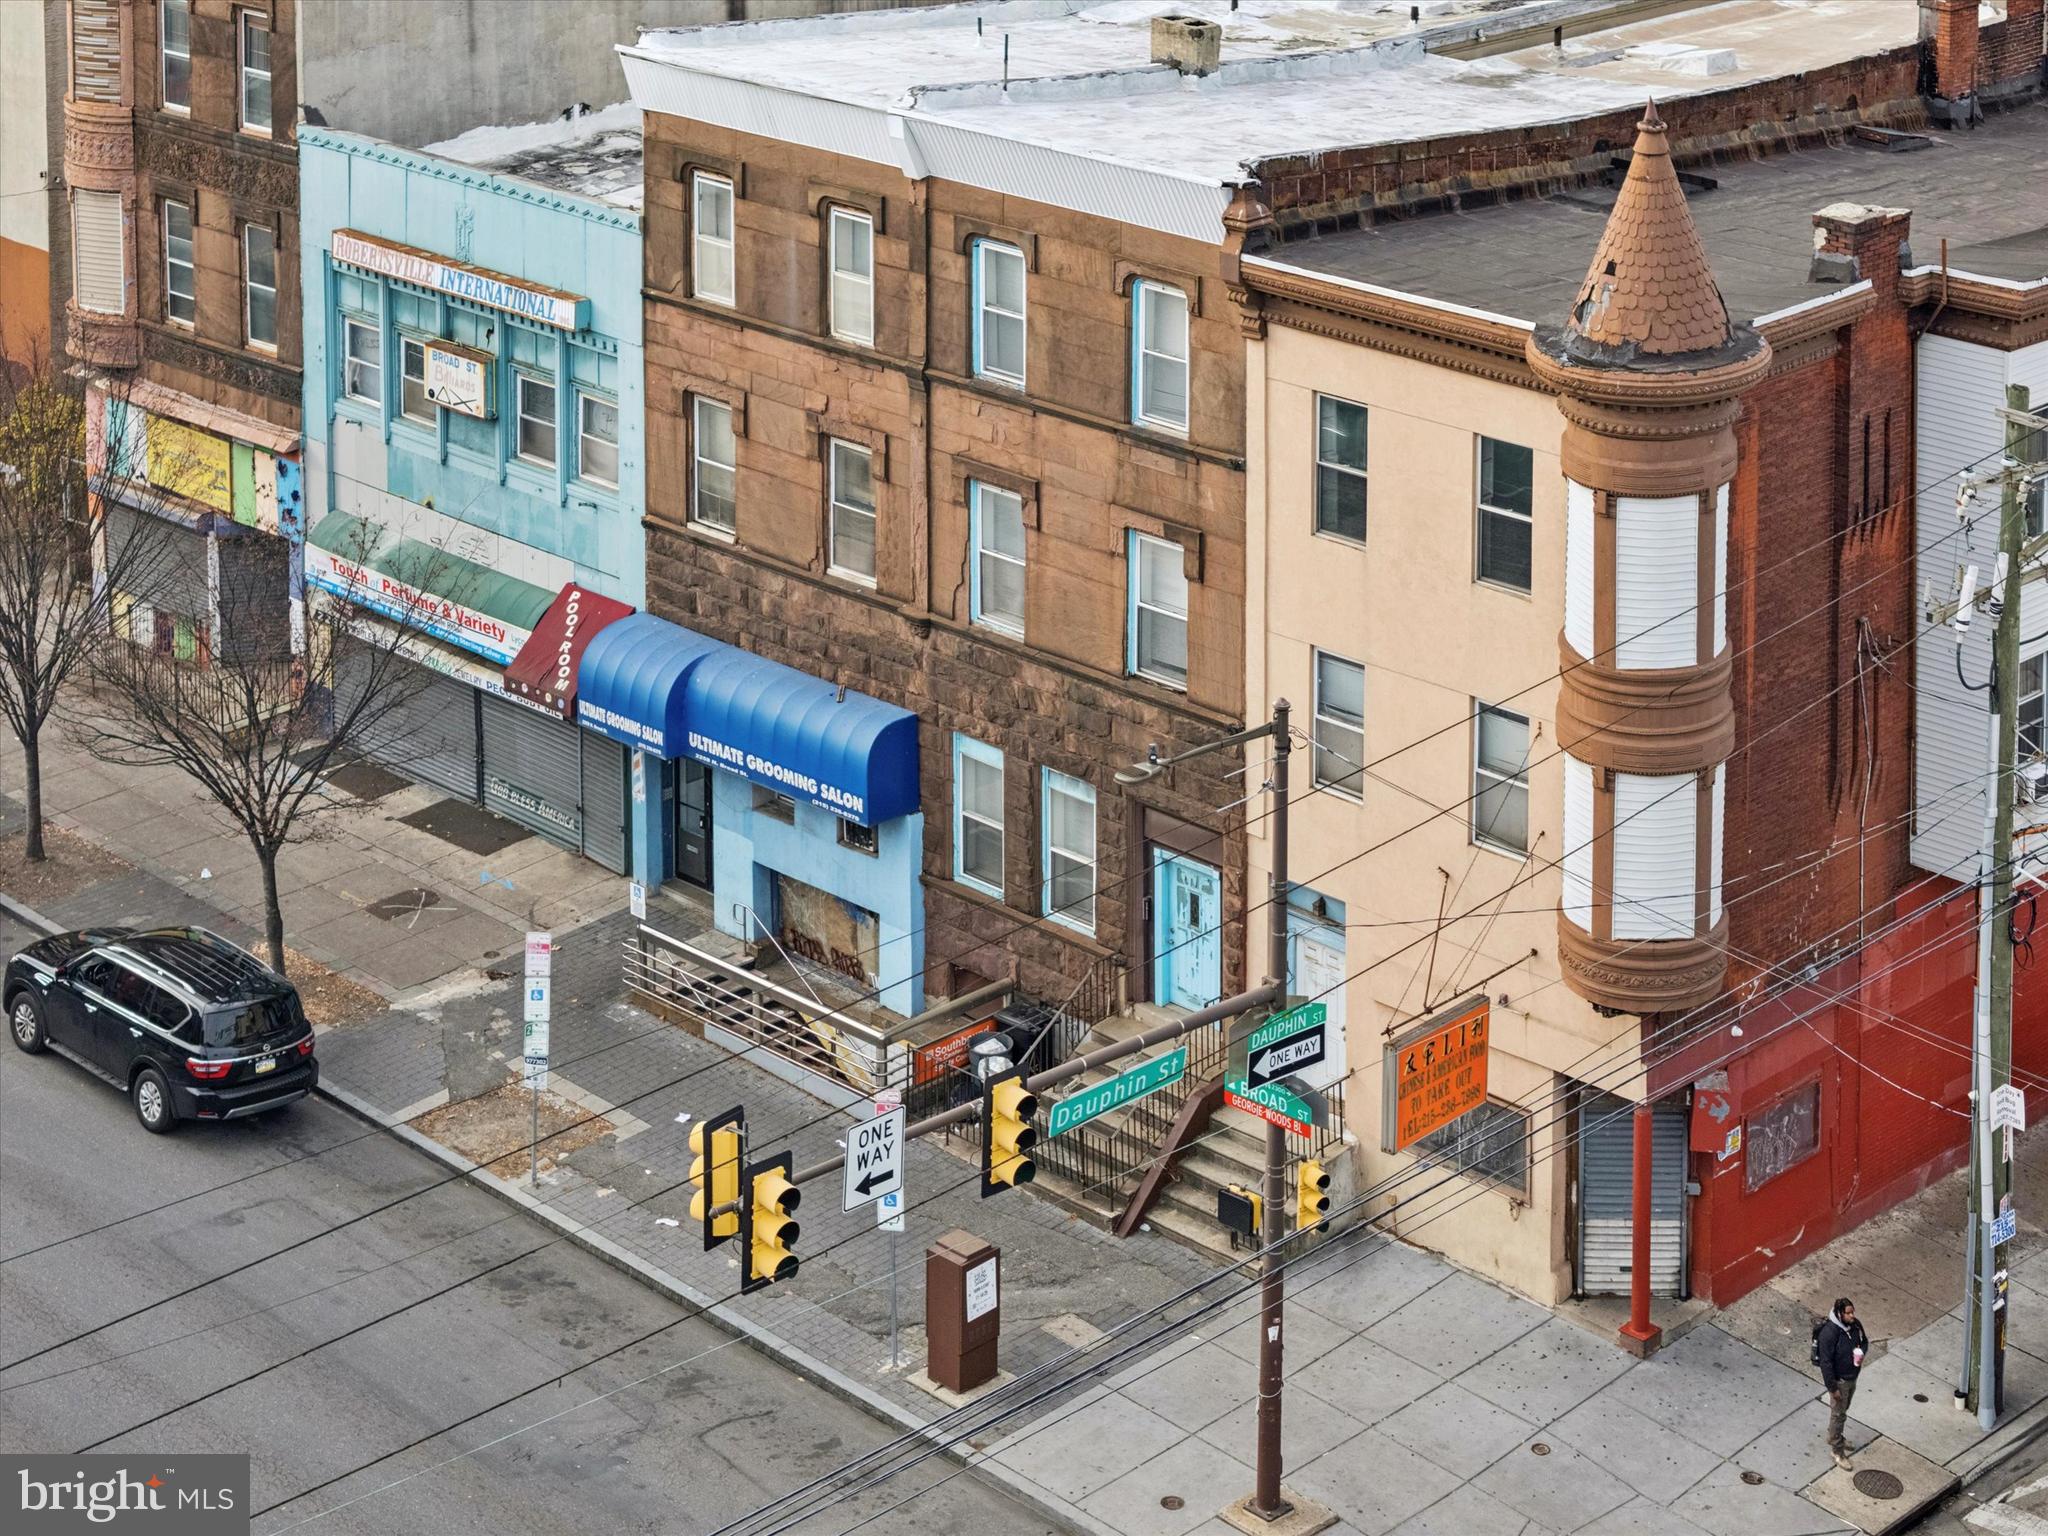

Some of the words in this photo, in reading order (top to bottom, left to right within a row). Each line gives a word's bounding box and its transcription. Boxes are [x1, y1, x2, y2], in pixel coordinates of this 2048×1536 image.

[335, 236, 434, 283] ROBERTSVILLE
[439, 266, 556, 321] INTERNATIONAL
[432, 350, 460, 369] BROAD
[330, 557, 368, 585] Touch
[382, 579, 437, 613] Perfume
[442, 603, 452, 619] &
[455, 607, 506, 643] Variety
[565, 590, 581, 638] POOL
[554, 640, 572, 692] ROOM
[579, 699, 606, 724] ULTIMATE
[606, 710, 642, 738] GROOMING
[642, 724, 664, 747] SALON
[688, 732, 744, 766] ULTIMATE
[746, 754, 818, 795] GROOMING
[820, 783, 864, 814] SALON
[509, 791, 536, 812] BLESS
[537, 799, 575, 831] AMERICA
[1251, 1013, 1307, 1049] DAUPHIN
[1312, 1010, 1324, 1024] ST
[1269, 1049, 1290, 1068] ONE
[1294, 1038, 1318, 1058] WAY
[1056, 1074, 1147, 1129] Dauphin
[1158, 1057, 1179, 1081] St
[1240, 1081, 1288, 1113] BROAD
[1297, 1109, 1309, 1122] ST
[1427, 1079, 1450, 1107] TAKE
[1455, 1066, 1473, 1090] OUT
[859, 1118, 894, 1148] ONE
[1231, 1094, 1263, 1116] GEORGIE
[1265, 1107, 1292, 1130] WOODS
[1293, 1121, 1303, 1134] BL
[857, 1139, 895, 1171] WAY
[1996, 1220, 2009, 1232] 215
